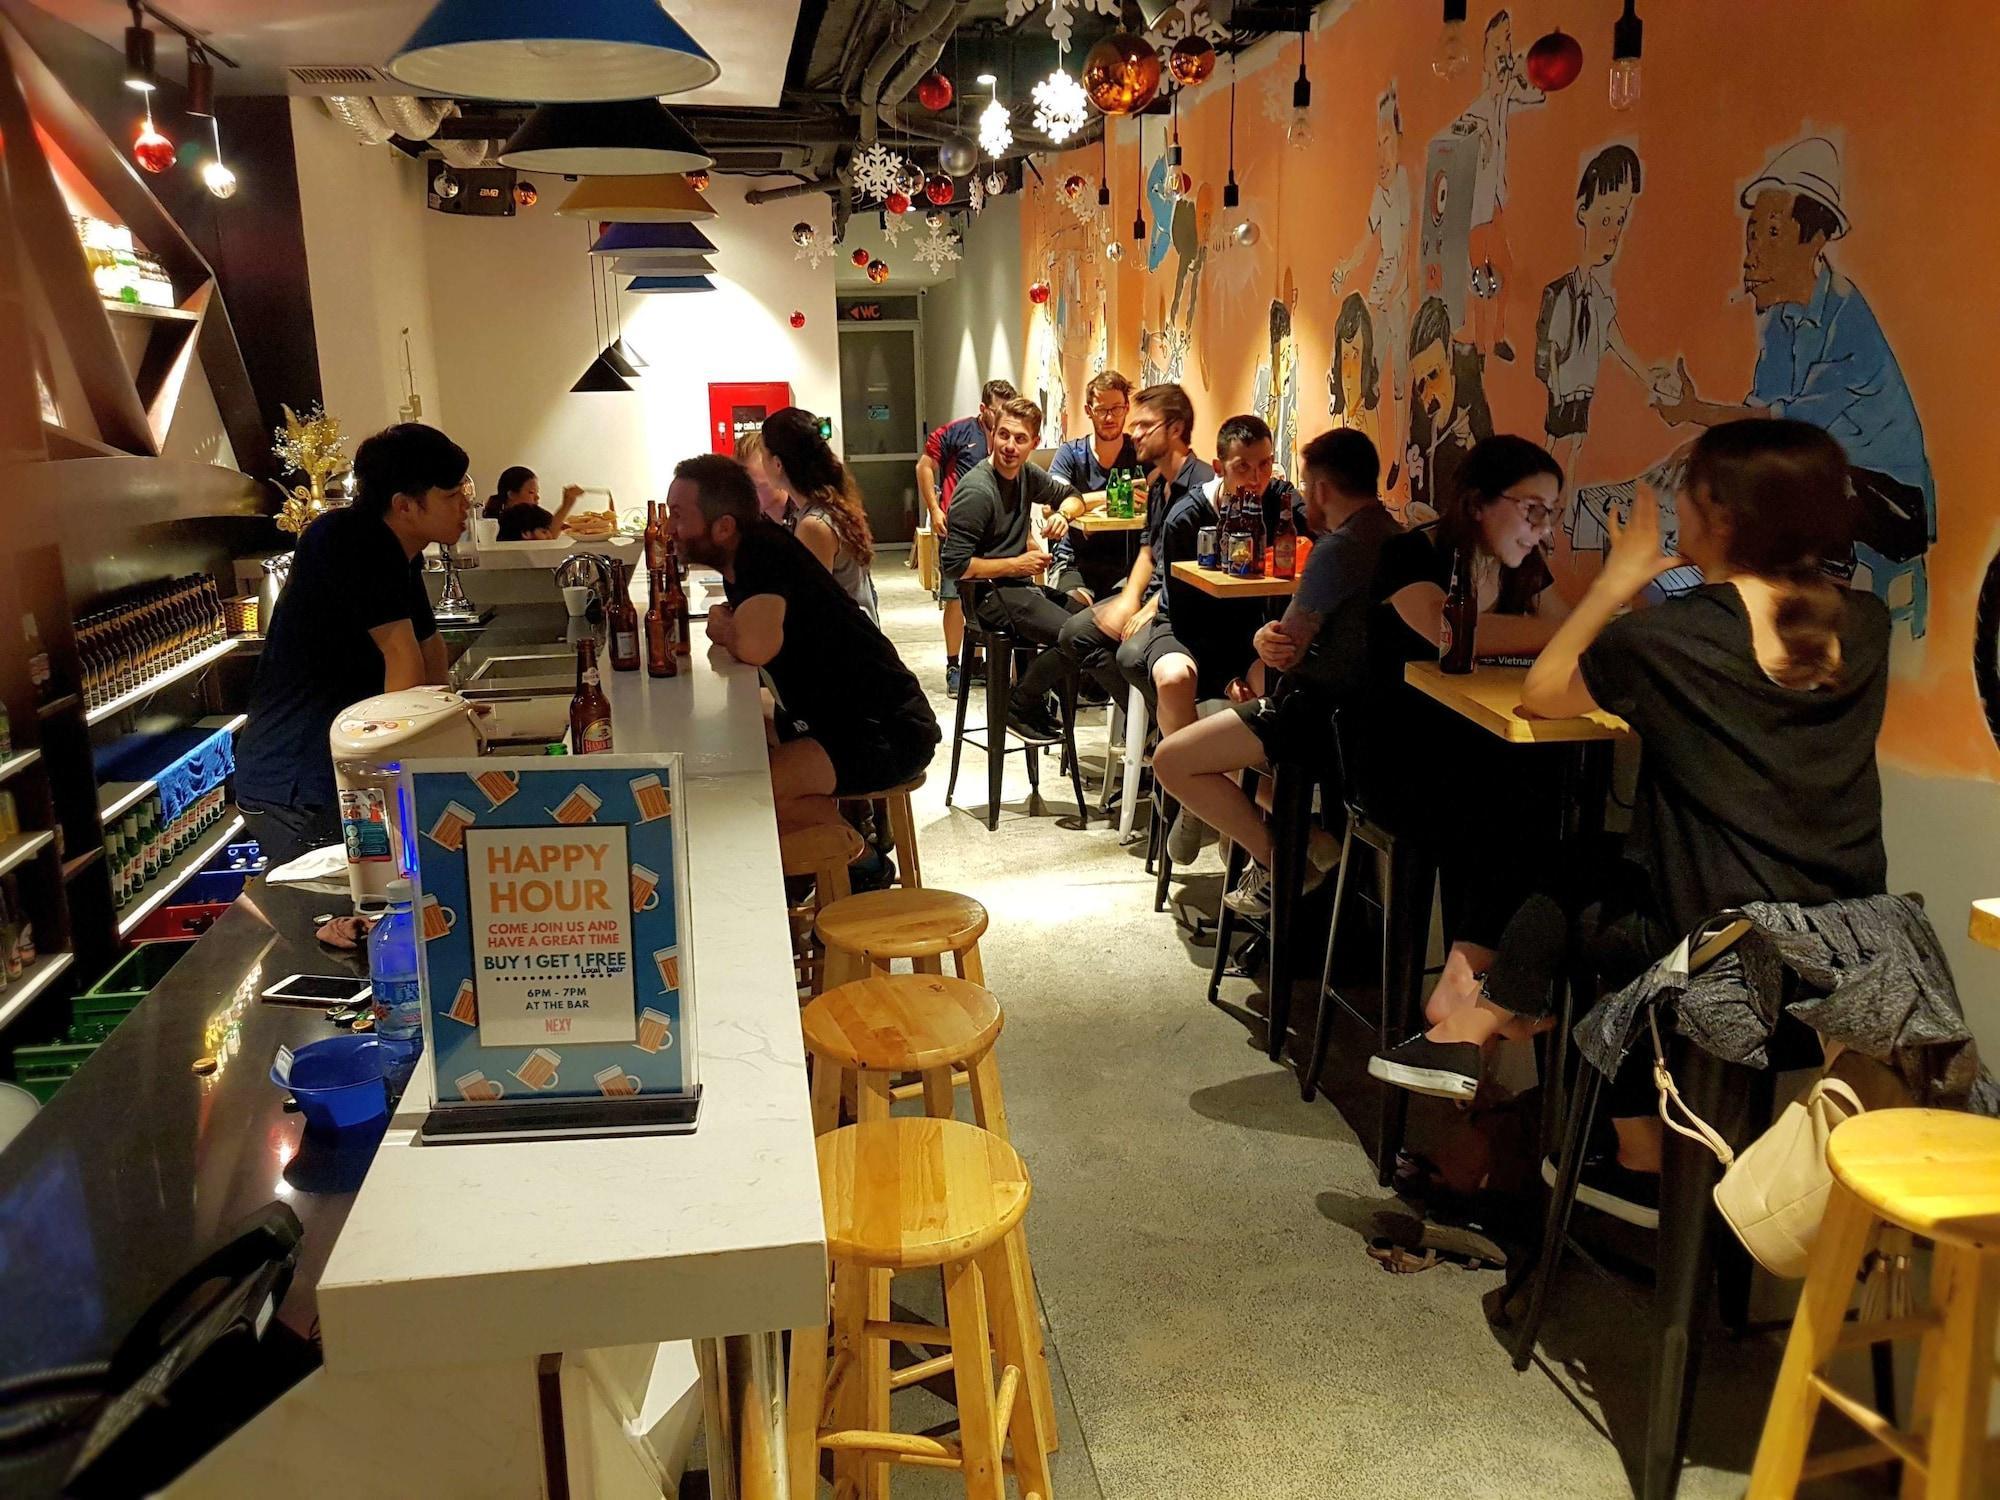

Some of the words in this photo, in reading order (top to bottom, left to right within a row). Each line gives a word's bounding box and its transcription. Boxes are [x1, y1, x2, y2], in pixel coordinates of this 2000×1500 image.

[860, 304, 880, 319] WC
[487, 843, 610, 874] HAPPY
[489, 879, 613, 914] HOUR
[488, 922, 529, 935] COME
[531, 921, 563, 934] JOIN
[566, 921, 585, 933] US
[588, 920, 618, 931] AND
[488, 937, 525, 948] HAVE
[528, 936, 538, 947] A
[541, 934, 586, 947] GREAT
[588, 933, 620, 945] TIME
[484, 955, 520, 970] BUY
[524, 955, 531, 969] 1
[536, 953, 570, 968] GET
[574, 953, 581, 967] 1
[586, 952, 626, 966] FREE
[527, 988, 552, 998] 6PM
[563, 987, 587, 997] 7PM
[525, 1001, 540, 1011] AT
[543, 1000, 564, 1010] THE
[567, 1000, 590, 1009] BAR
[544, 1017, 572, 1033] NEXY
